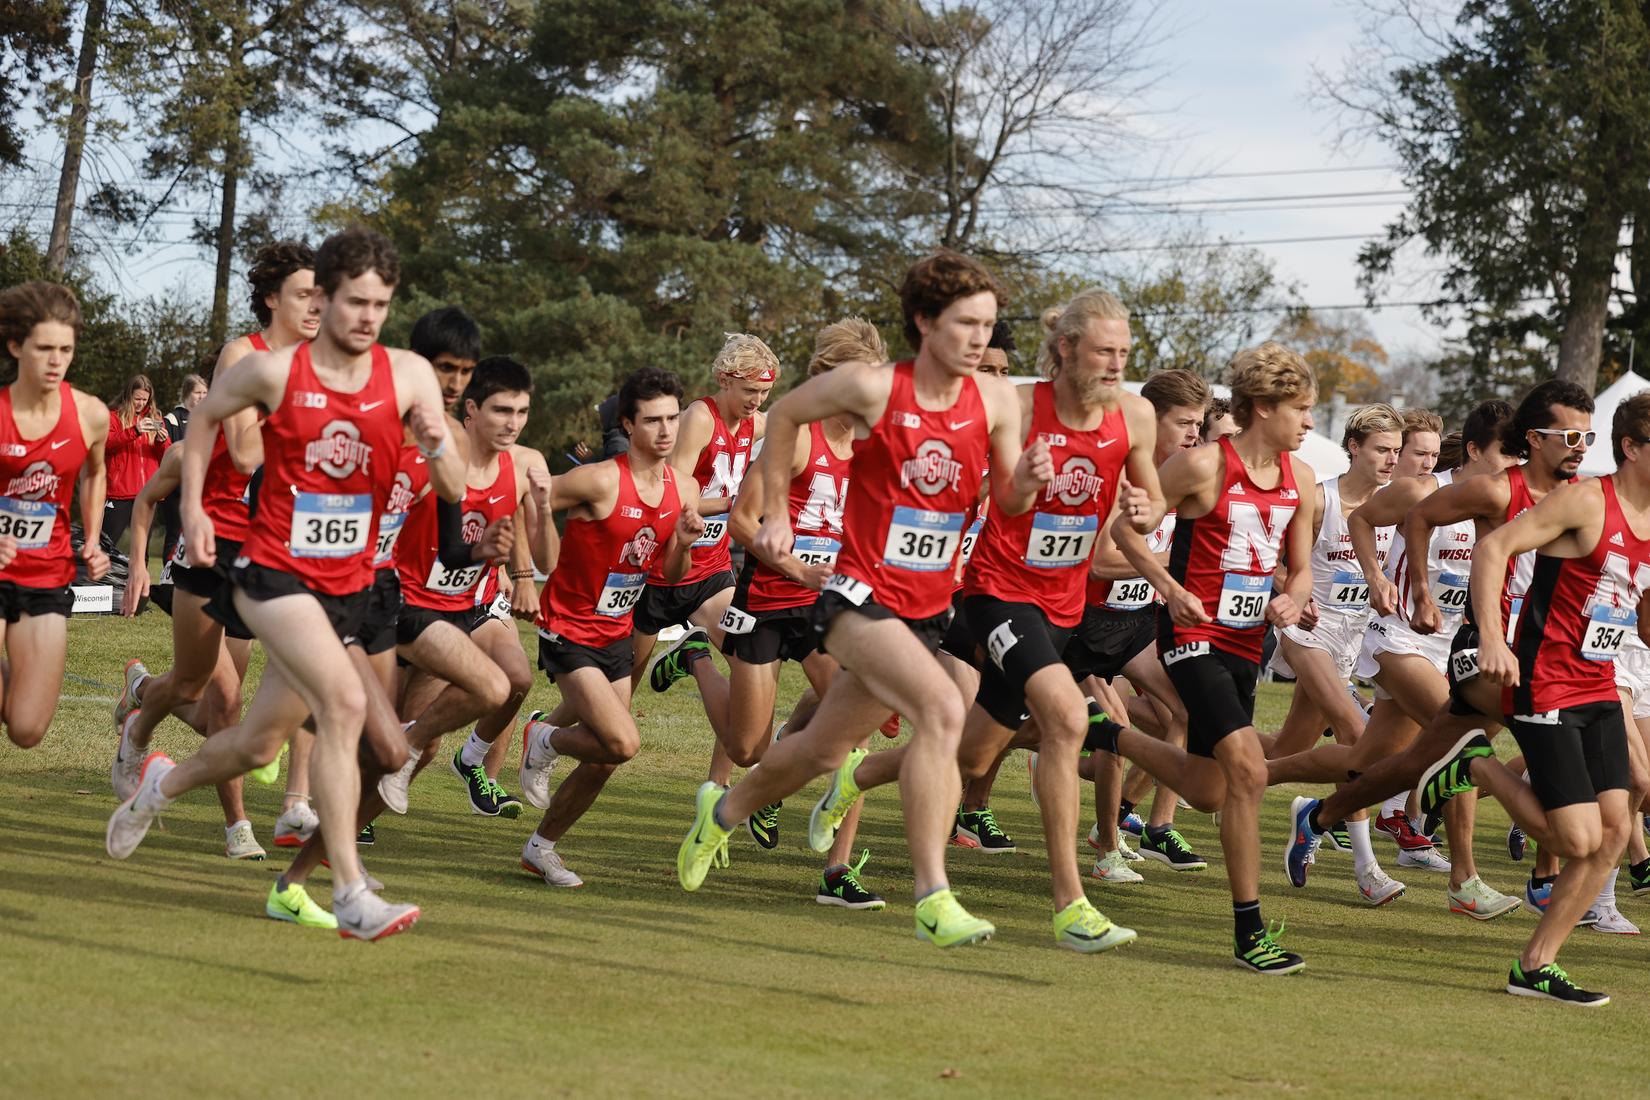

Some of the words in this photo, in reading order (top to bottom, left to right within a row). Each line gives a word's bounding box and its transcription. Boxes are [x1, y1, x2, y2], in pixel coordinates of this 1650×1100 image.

[0, 515, 44, 539] 367
[306, 519, 359, 544] 365
[1219, 501, 1297, 573] N
[899, 532, 948, 559] 361
[1040, 535, 1083, 556] 371
[438, 567, 479, 588] 363
[74, 594, 110, 603] Wisconsin
[607, 589, 640, 609] 362
[1117, 583, 1150, 601] 348
[1337, 586, 1370, 602] 414
[1439, 589, 1467, 605] 40
[1229, 595, 1264, 617] 350
[1591, 627, 1625, 650] 354
